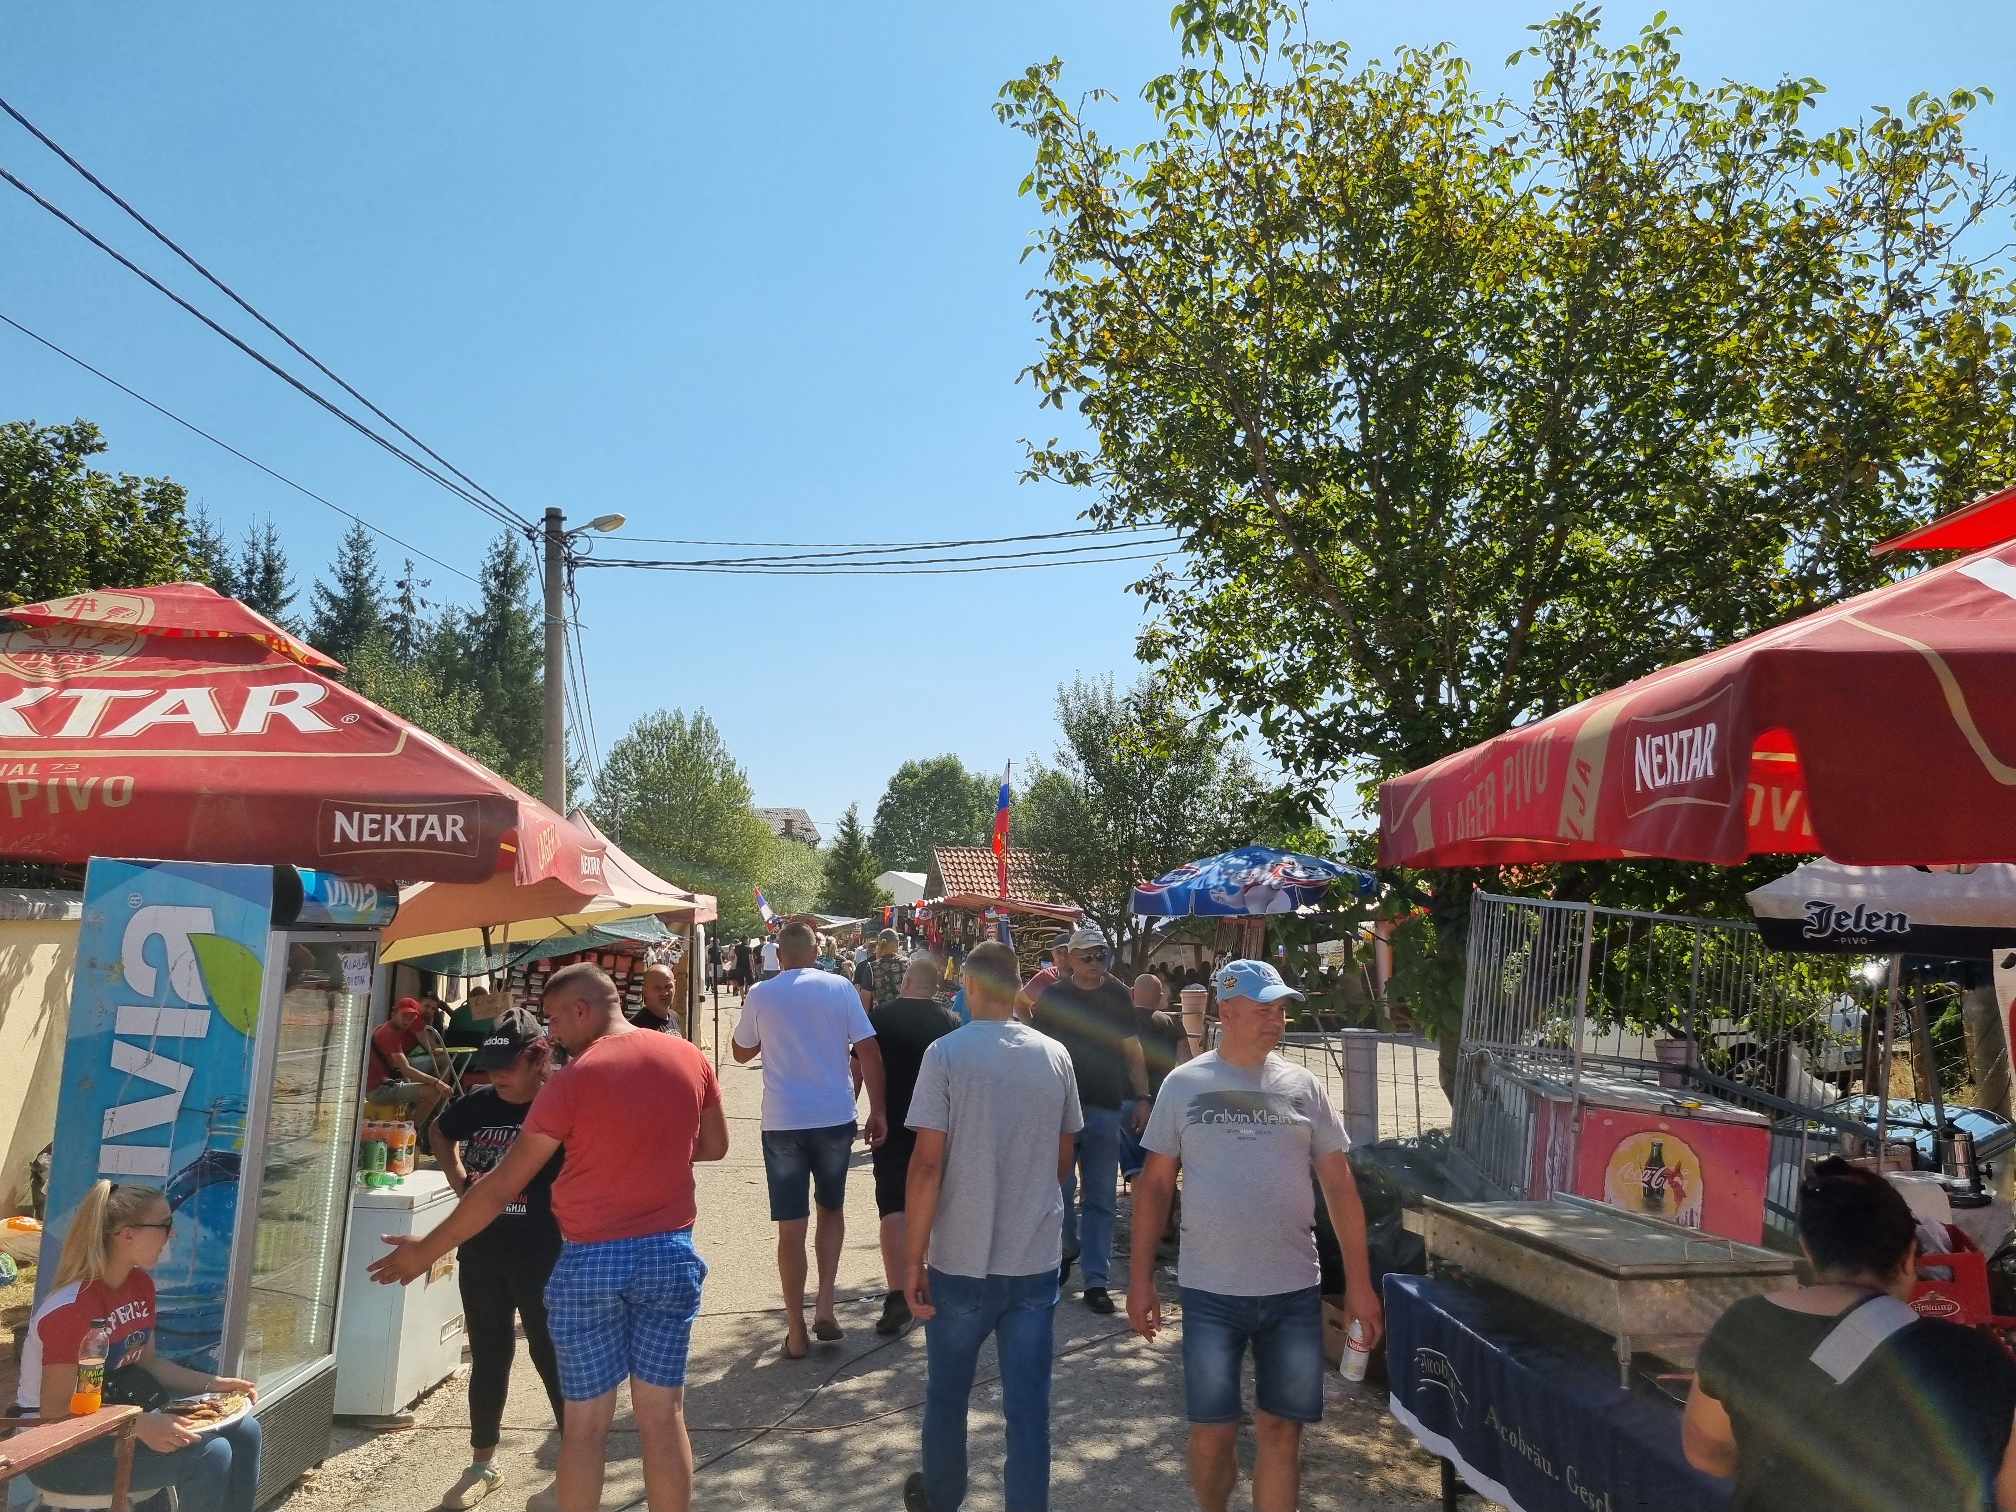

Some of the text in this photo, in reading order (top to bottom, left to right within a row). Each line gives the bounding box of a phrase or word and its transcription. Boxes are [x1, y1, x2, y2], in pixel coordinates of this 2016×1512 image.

[1502, 726, 1557, 822] PIVO
[1634, 722, 1718, 793] NEKTAR
[8, 775, 136, 819] PIVO
[333, 810, 468, 843] NEKTAR
[1802, 900, 1914, 939] Jelen
[1840, 936, 1869, 945] PIVO
[1201, 1108, 1250, 1124] Calvin
